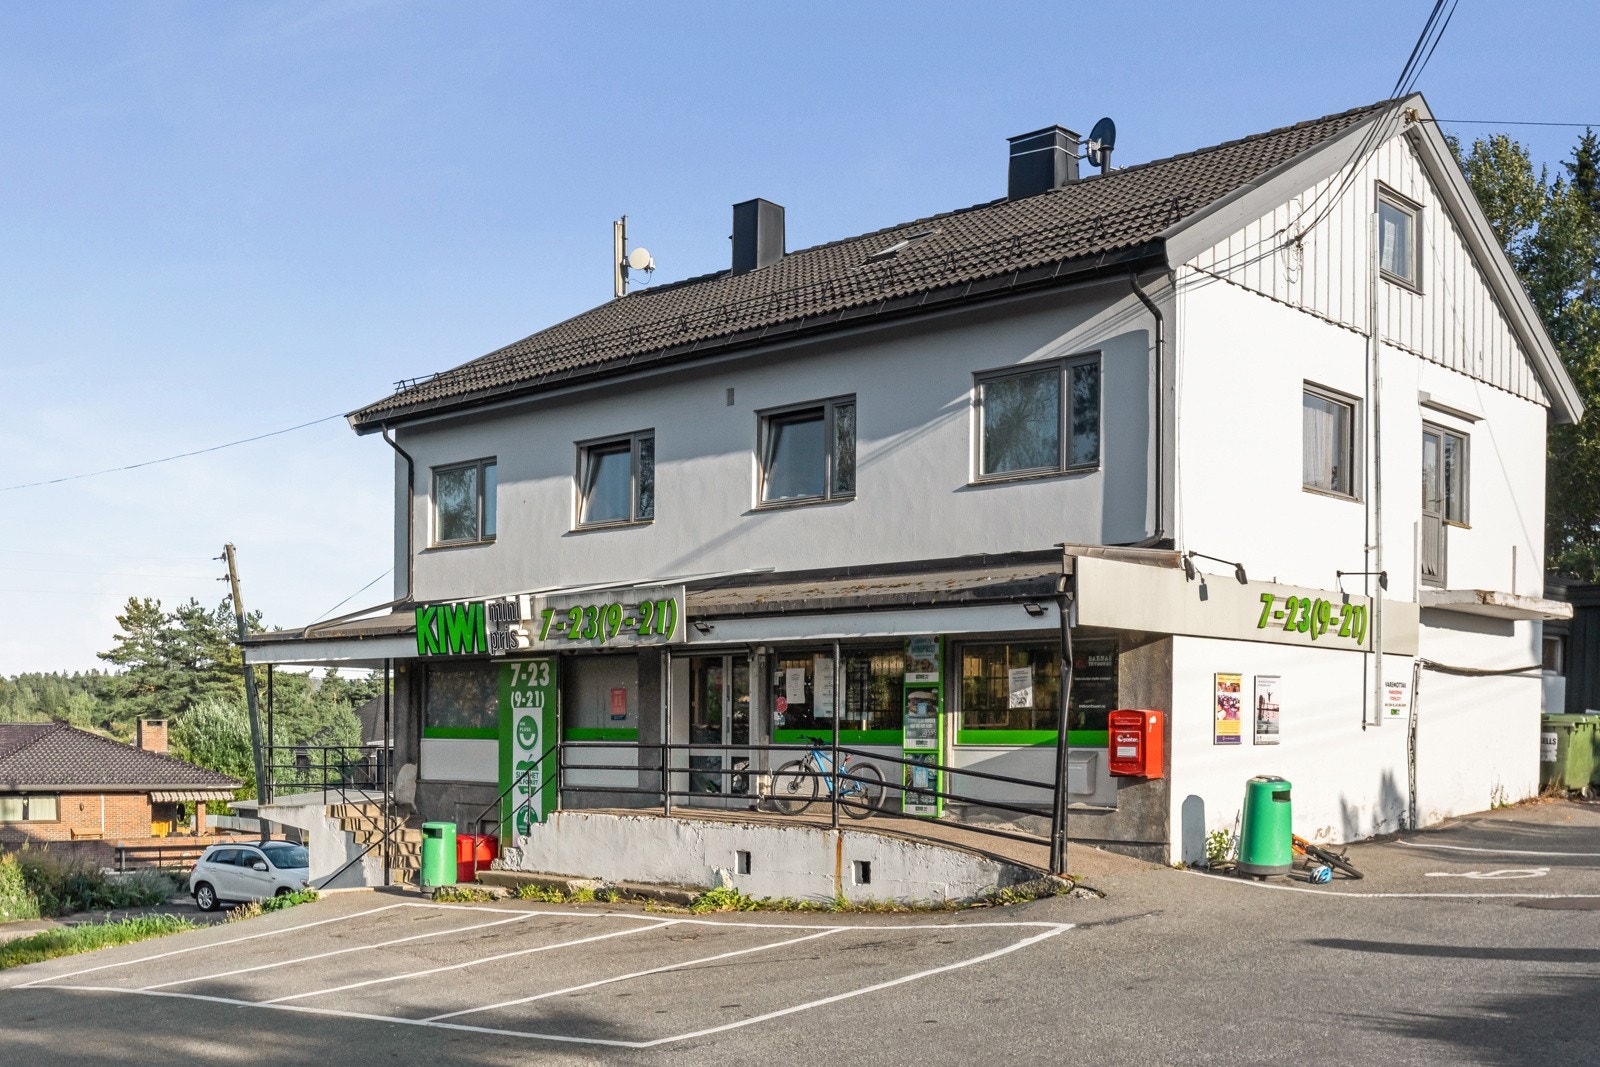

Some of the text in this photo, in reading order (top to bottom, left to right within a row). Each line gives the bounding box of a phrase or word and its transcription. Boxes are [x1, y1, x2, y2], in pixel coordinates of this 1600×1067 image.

[488, 597, 521, 622] mini
[538, 597, 678, 645] 7-23(9-21)
[1257, 593, 1367, 645] 7-23(9-21)
[414, 601, 487, 656] KIWI
[490, 625, 519, 655] pris
[511, 662, 550, 687] 7-23
[511, 690, 545, 709] (9-21)
